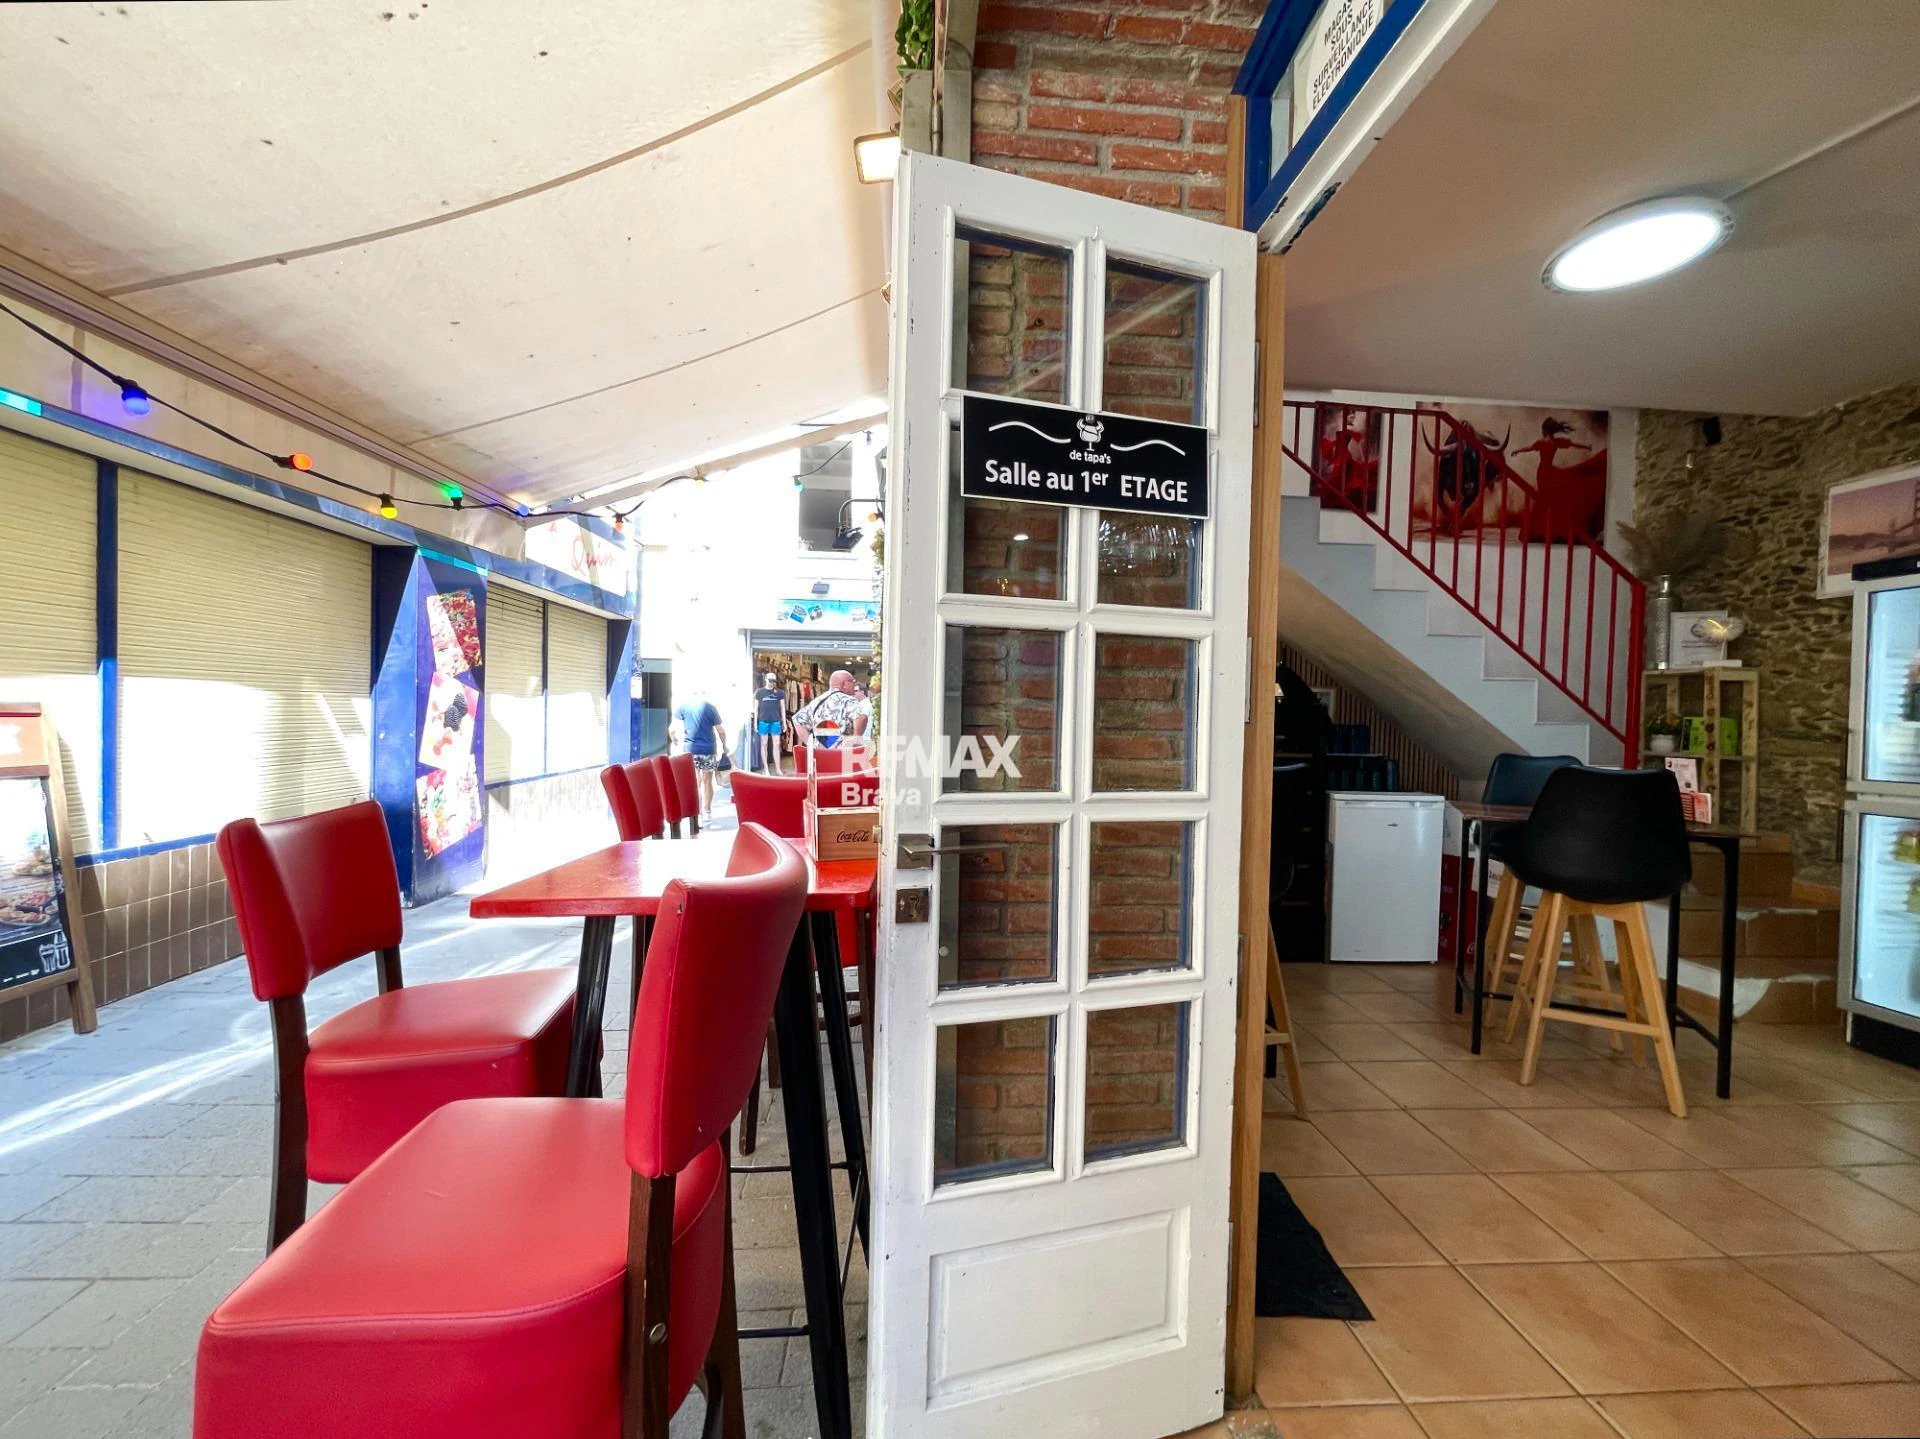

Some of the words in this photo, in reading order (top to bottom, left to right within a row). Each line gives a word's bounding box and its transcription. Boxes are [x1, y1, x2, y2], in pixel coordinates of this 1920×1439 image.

[1331, 8, 1353, 51] SOUS
[1312, 10, 1374, 110] ELECTRONIQUE
[1069, 450, 1082, 460] de
[1084, 451, 1112, 464] tapa's
[985, 459, 1041, 488] Salle
[1046, 471, 1074, 491] au
[1081, 470, 1109, 493] 1er
[1120, 474, 1189, 503] ETAGE
